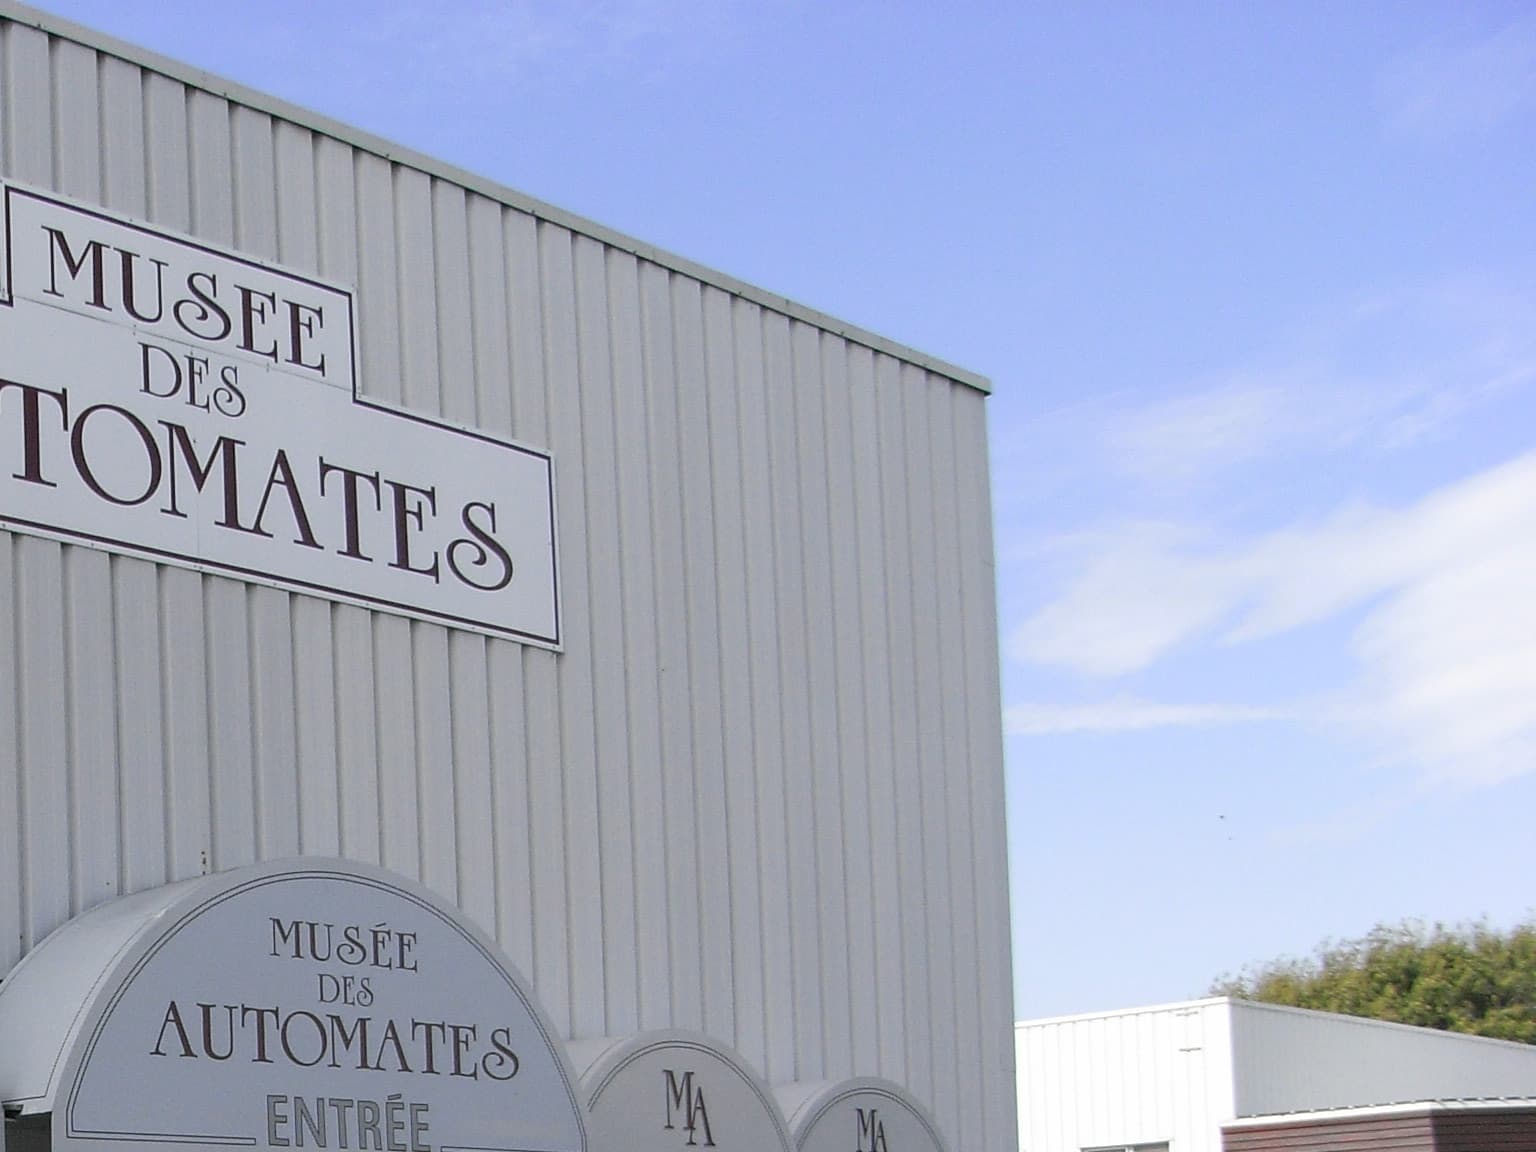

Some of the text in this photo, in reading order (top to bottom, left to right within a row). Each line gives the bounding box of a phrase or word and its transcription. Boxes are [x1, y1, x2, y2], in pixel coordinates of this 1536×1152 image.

[42, 225, 326, 376] MUSEE
[137, 342, 247, 419] DES
[269, 917, 419, 973] MUSÉE
[318, 974, 375, 1007] DES
[150, 1001, 521, 1082] AUTOMATES
[663, 1069, 717, 1148] MA
